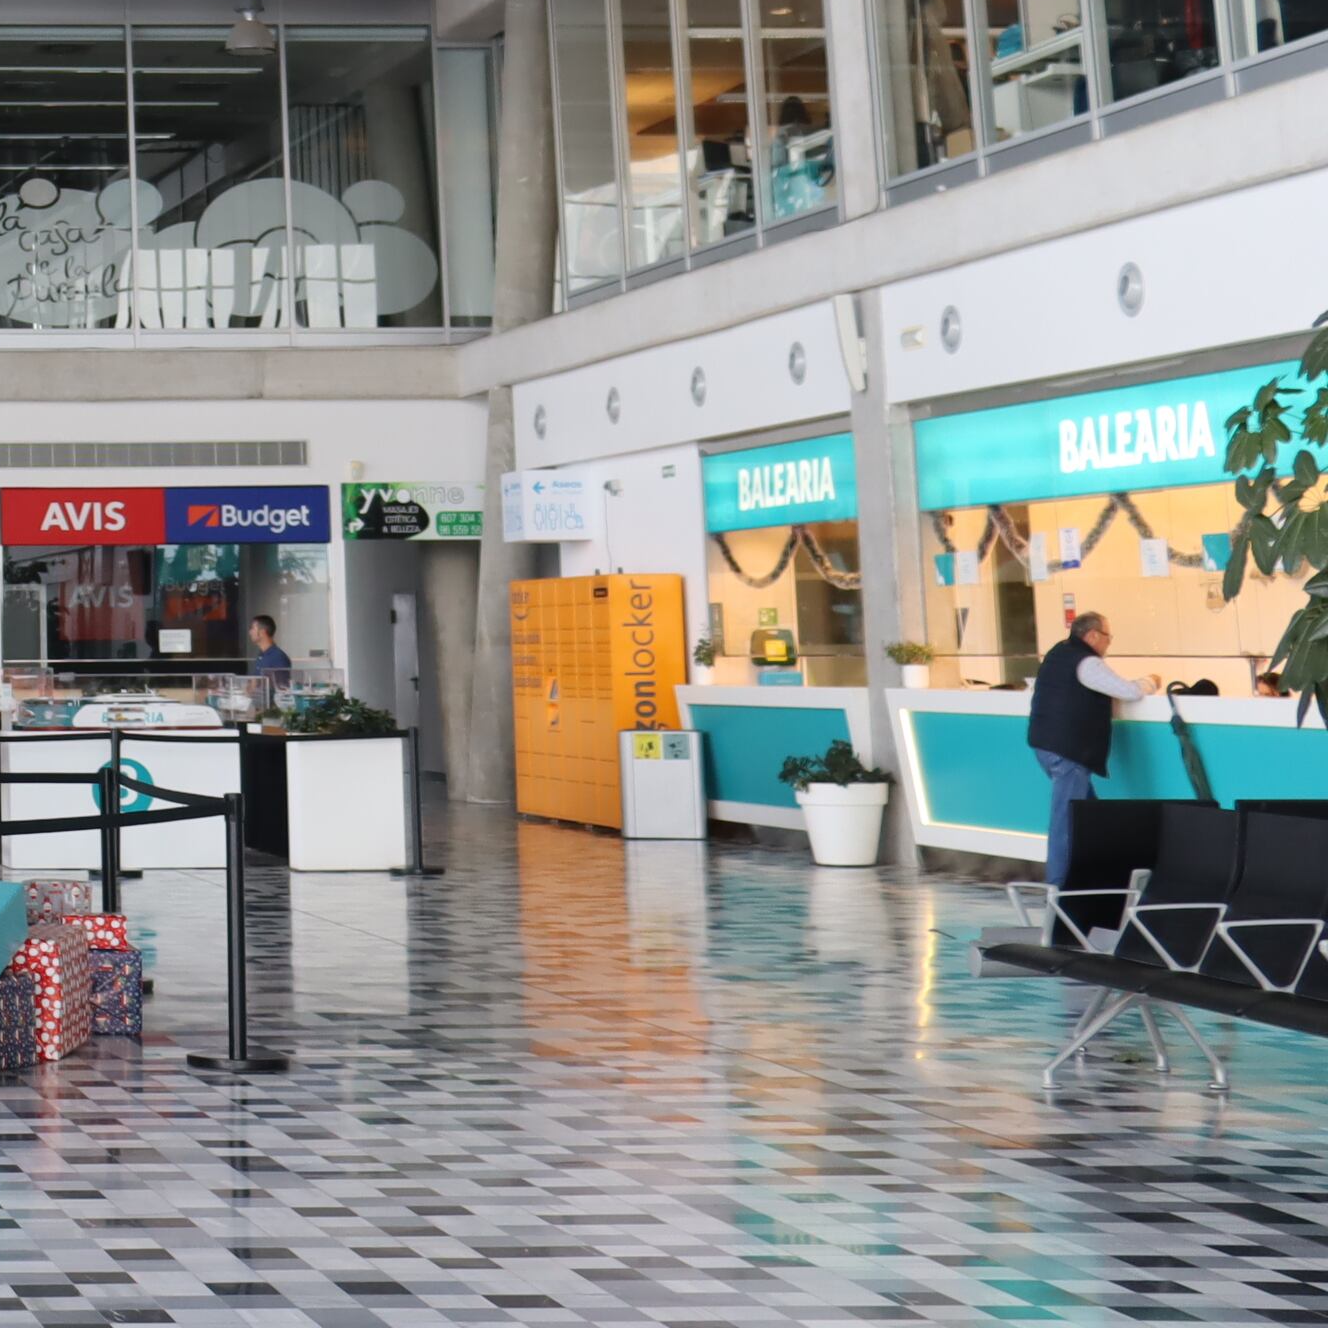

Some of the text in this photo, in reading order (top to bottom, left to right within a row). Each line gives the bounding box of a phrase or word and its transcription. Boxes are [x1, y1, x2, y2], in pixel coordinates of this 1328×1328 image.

[358, 485, 465, 515] yvonne
[40, 501, 127, 532] AVIS
[221, 504, 311, 534] Budget
[67, 583, 135, 609] AVIS
